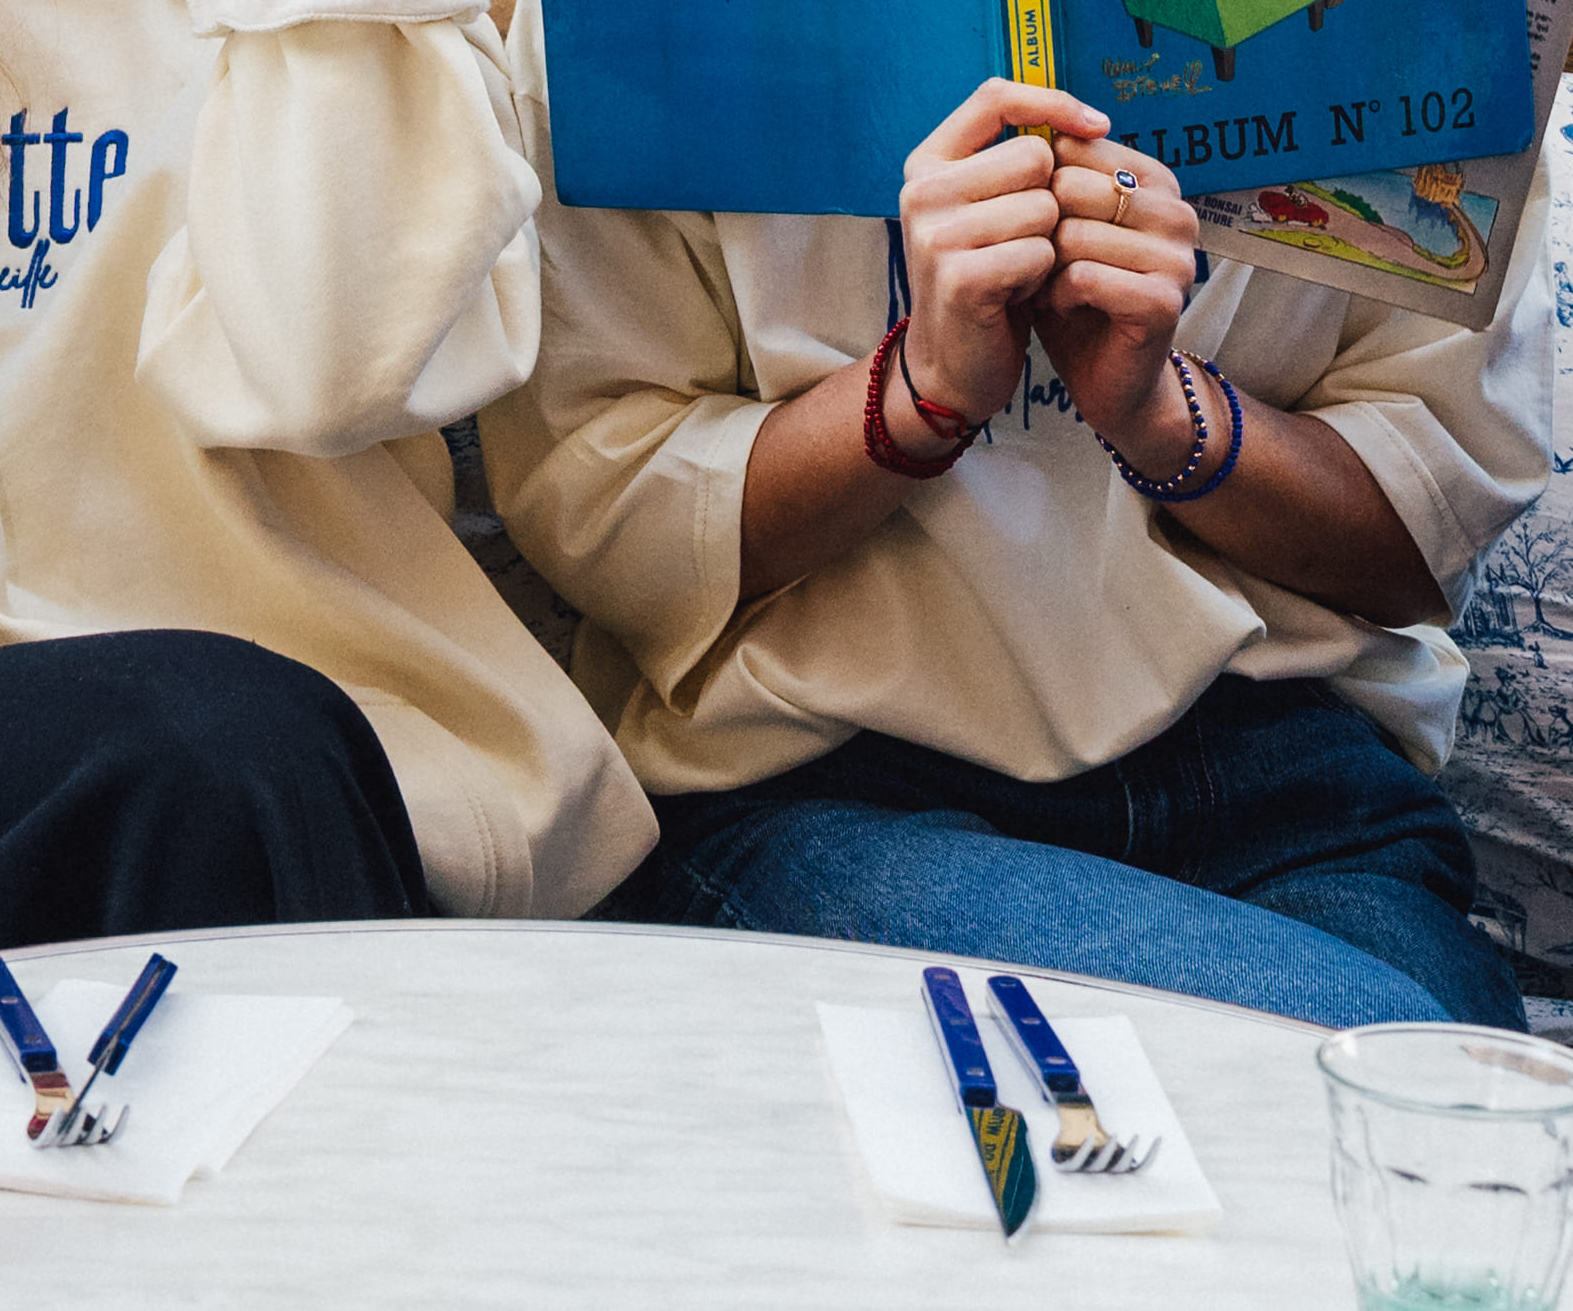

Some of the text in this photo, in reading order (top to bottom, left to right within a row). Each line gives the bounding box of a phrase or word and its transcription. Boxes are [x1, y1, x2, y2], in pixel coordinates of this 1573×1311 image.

[1024, 9, 1040, 68] ALBUM
[1399, 87, 1476, 137] 102
[1204, 196, 1243, 215] BONSAI
